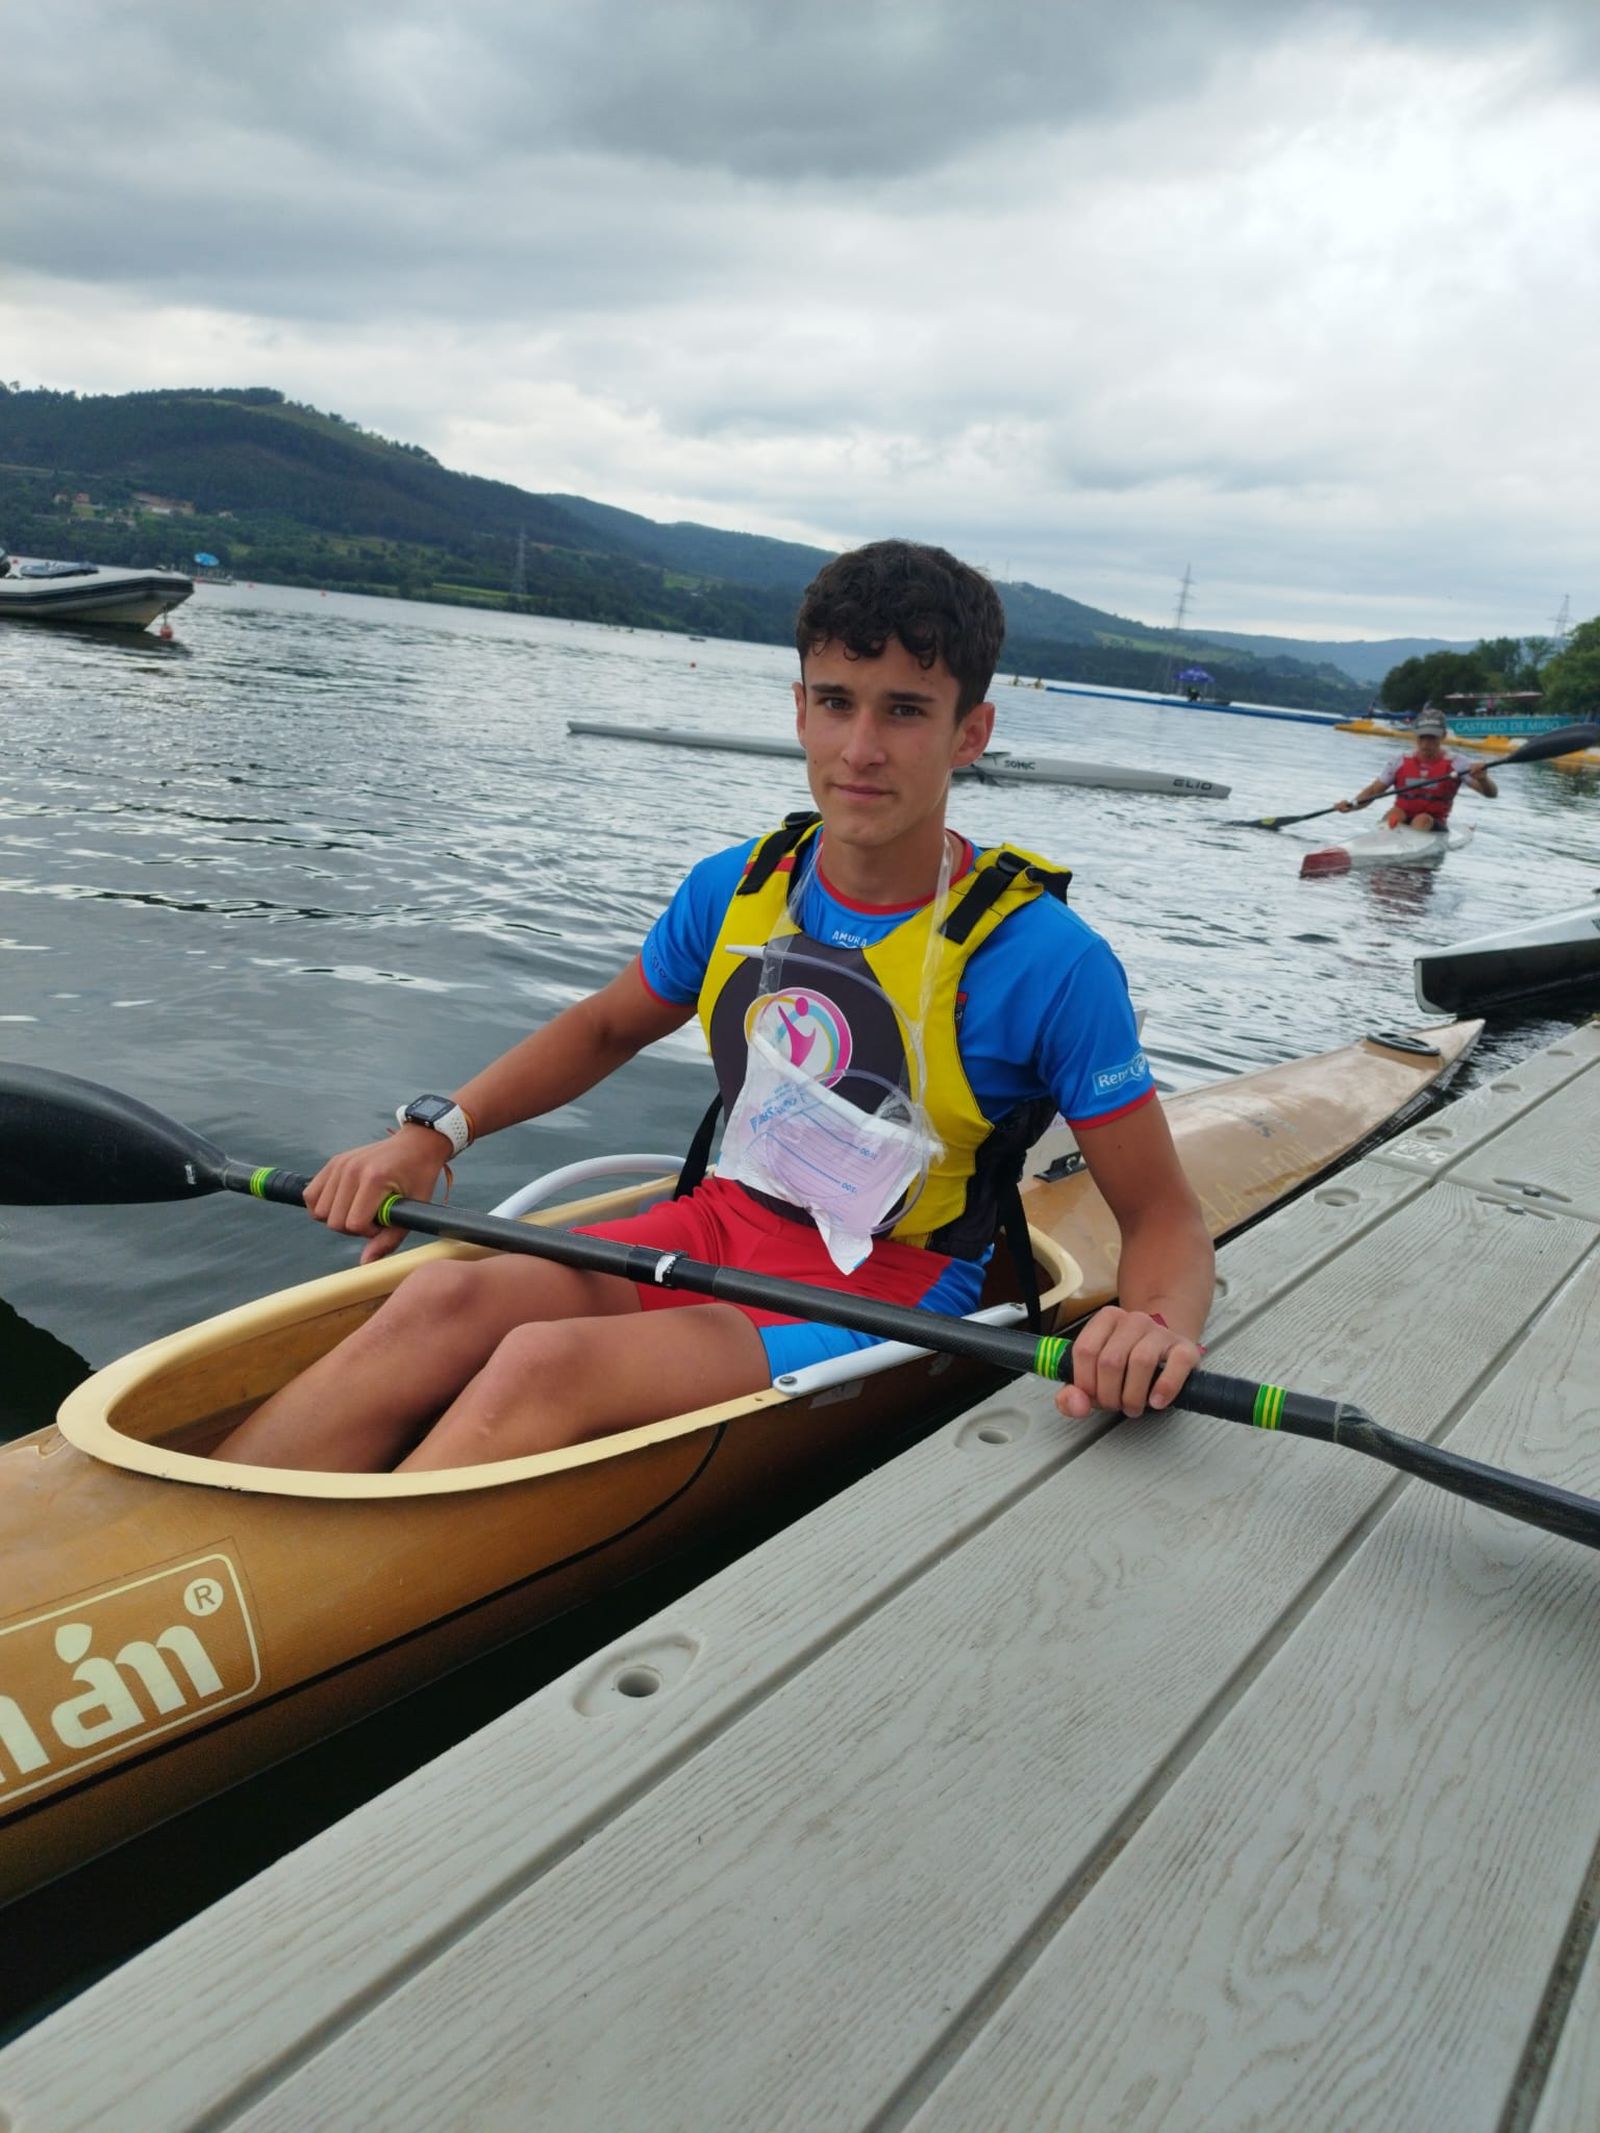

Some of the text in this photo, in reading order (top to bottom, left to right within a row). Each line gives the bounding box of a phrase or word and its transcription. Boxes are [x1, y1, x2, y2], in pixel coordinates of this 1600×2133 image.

[1510, 721, 1524, 731] DE
[1172, 778, 1213, 791] ELIO
[831, 929, 868, 947] AMURA
